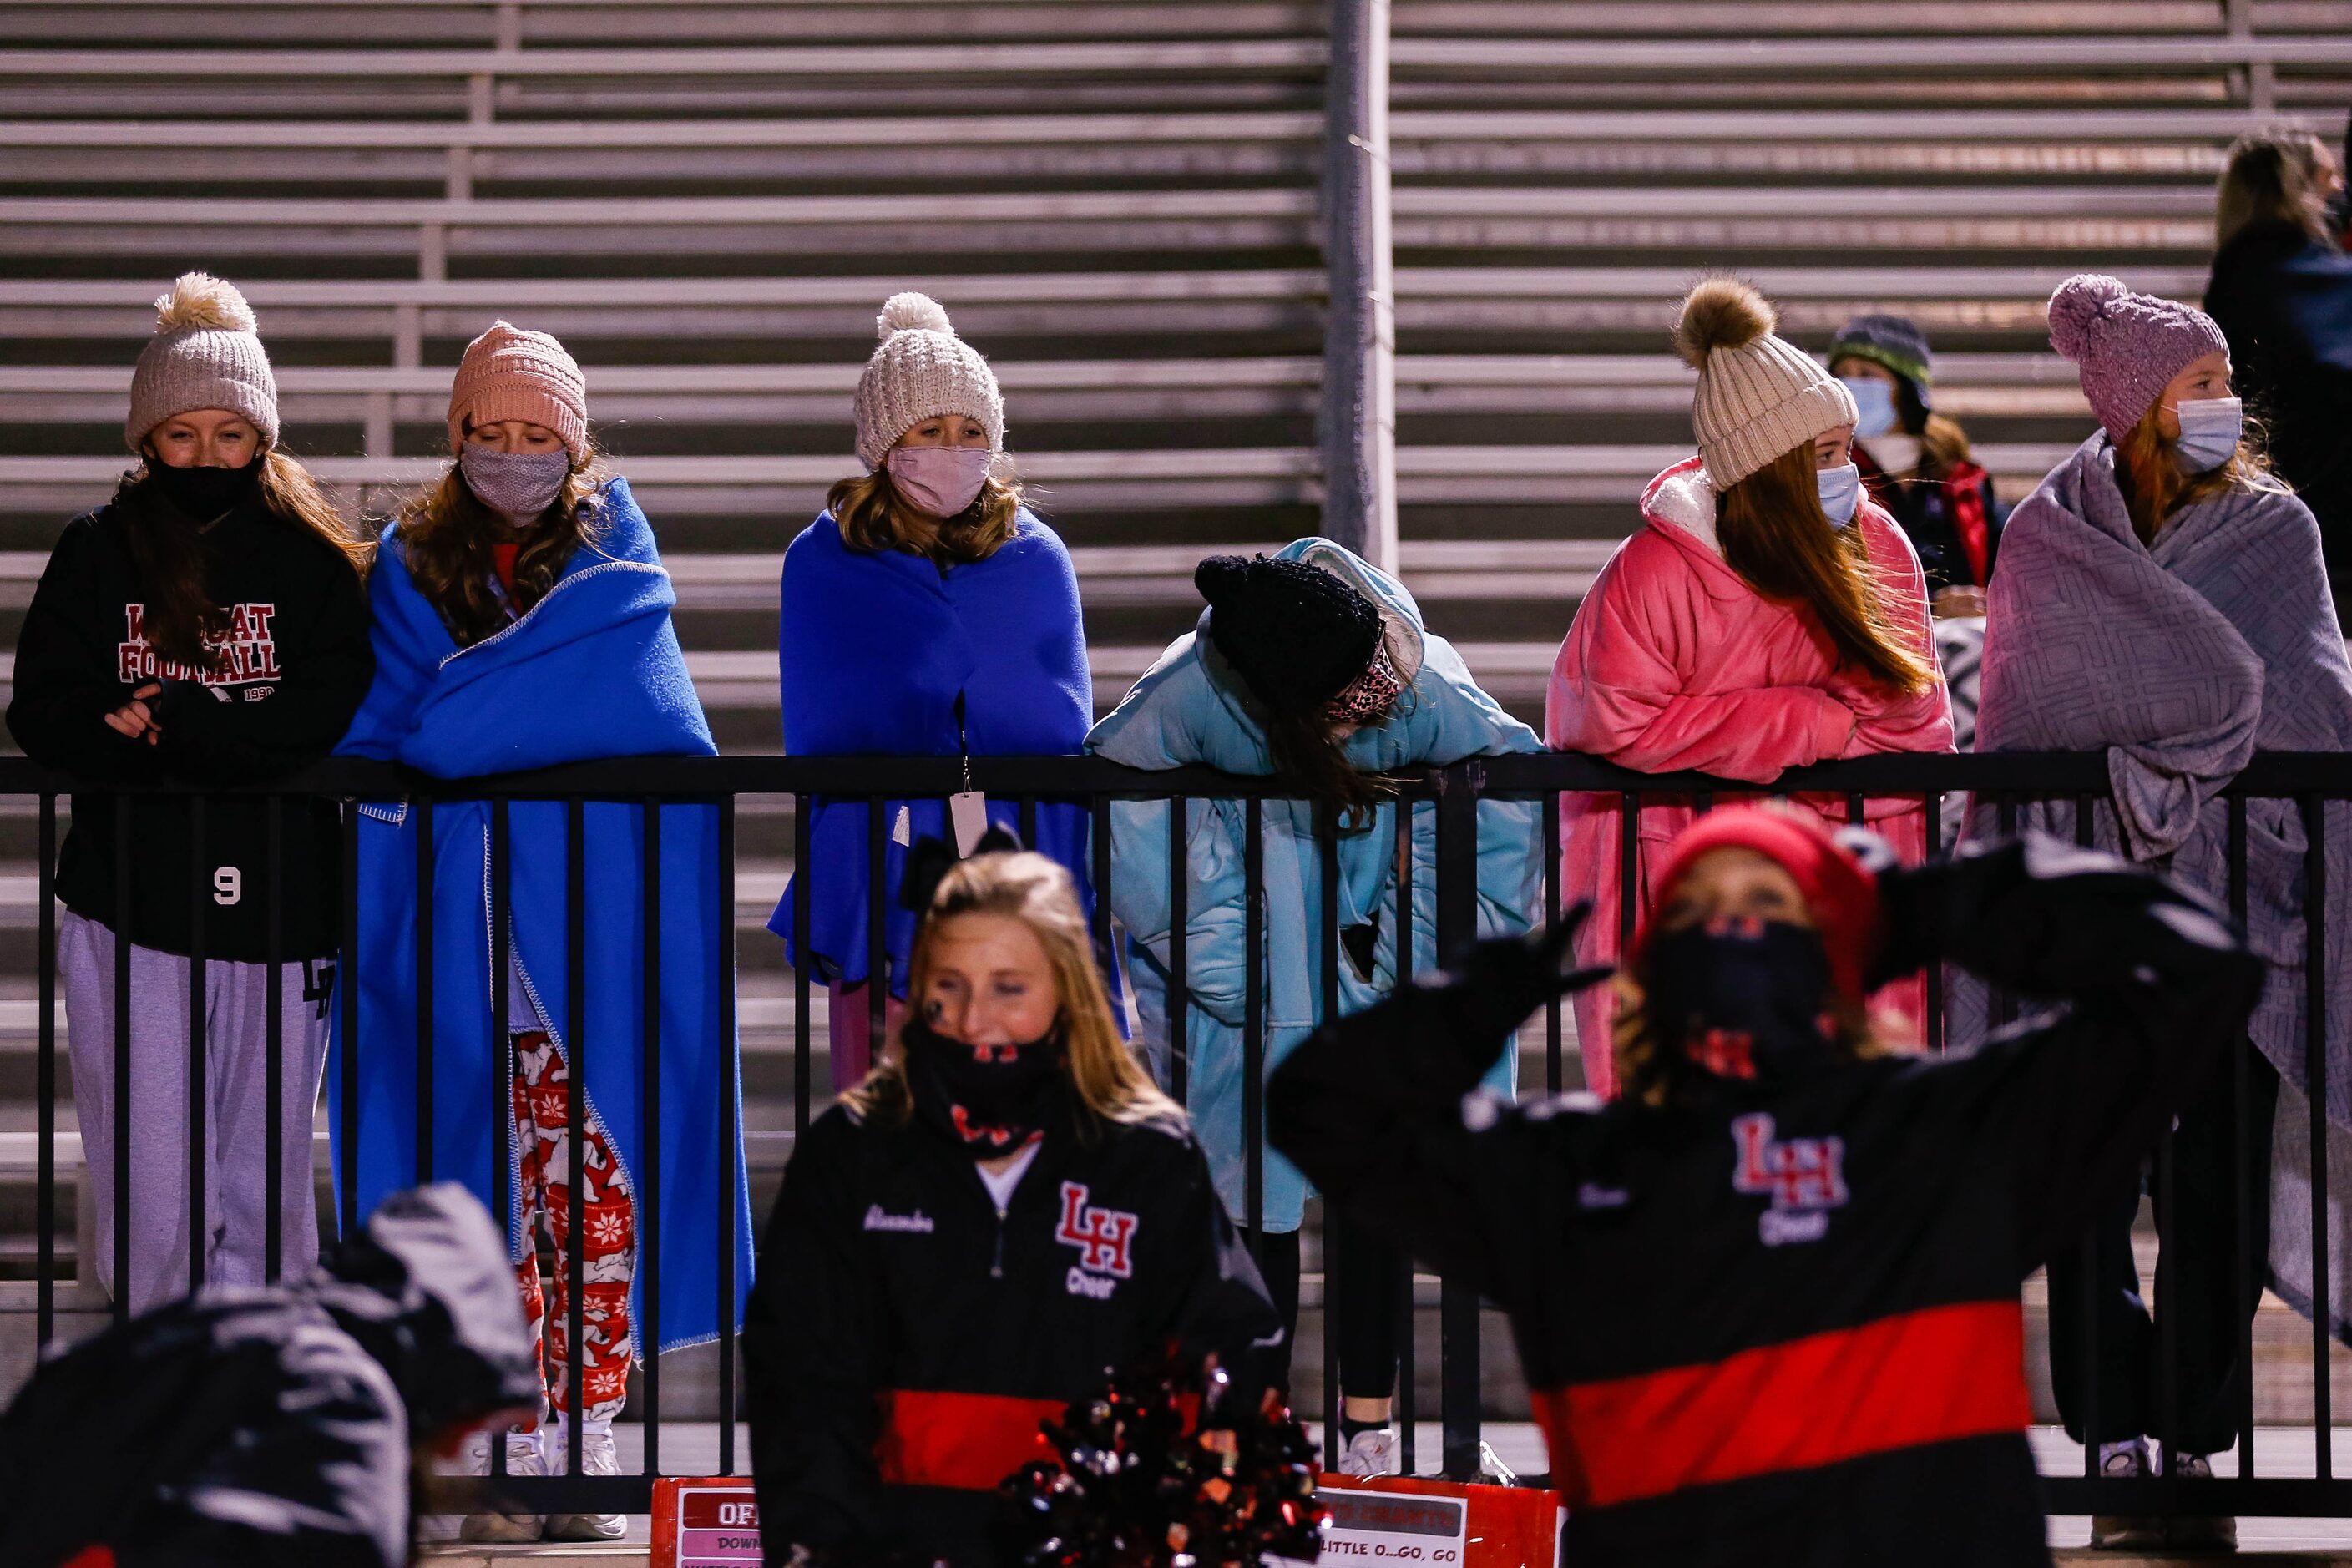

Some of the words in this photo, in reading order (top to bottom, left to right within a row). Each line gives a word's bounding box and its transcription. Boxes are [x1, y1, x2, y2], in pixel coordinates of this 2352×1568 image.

[126, 604, 276, 645] WCAT
[214, 867, 241, 905] 9
[1055, 1180, 1139, 1279] LH
[1320, 1540, 1368, 1555] LITTLE
[1433, 1550, 1456, 1562] GO
